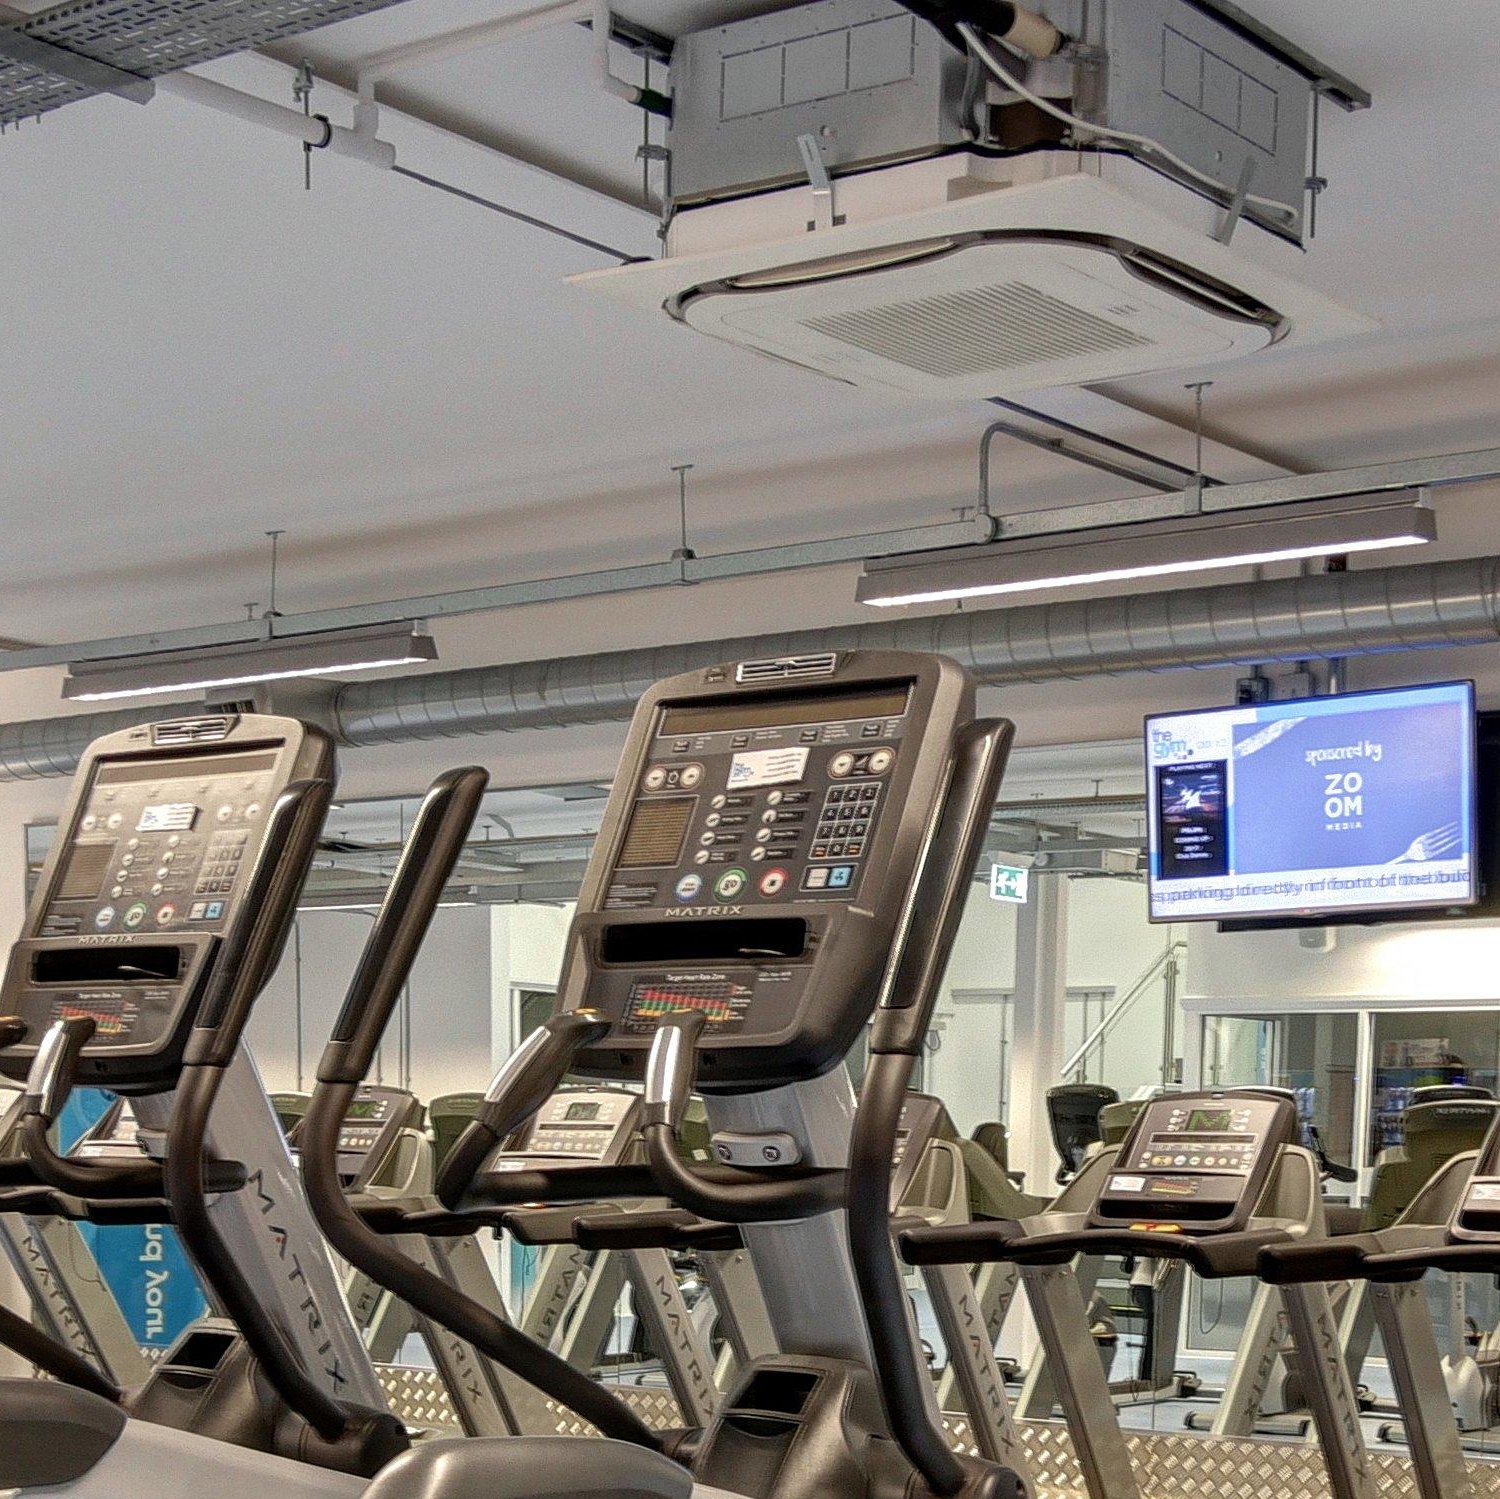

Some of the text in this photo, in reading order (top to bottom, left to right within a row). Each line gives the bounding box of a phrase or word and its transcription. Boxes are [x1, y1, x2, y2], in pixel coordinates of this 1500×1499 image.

[1324, 772, 1363, 795] ZO
[1324, 796, 1363, 818] OM
[1324, 821, 1363, 831] MEDIA
[665, 905, 743, 917] MATRIX
[77, 935, 137, 945] MATRIX
[247, 1168, 346, 1394] MATRIX
